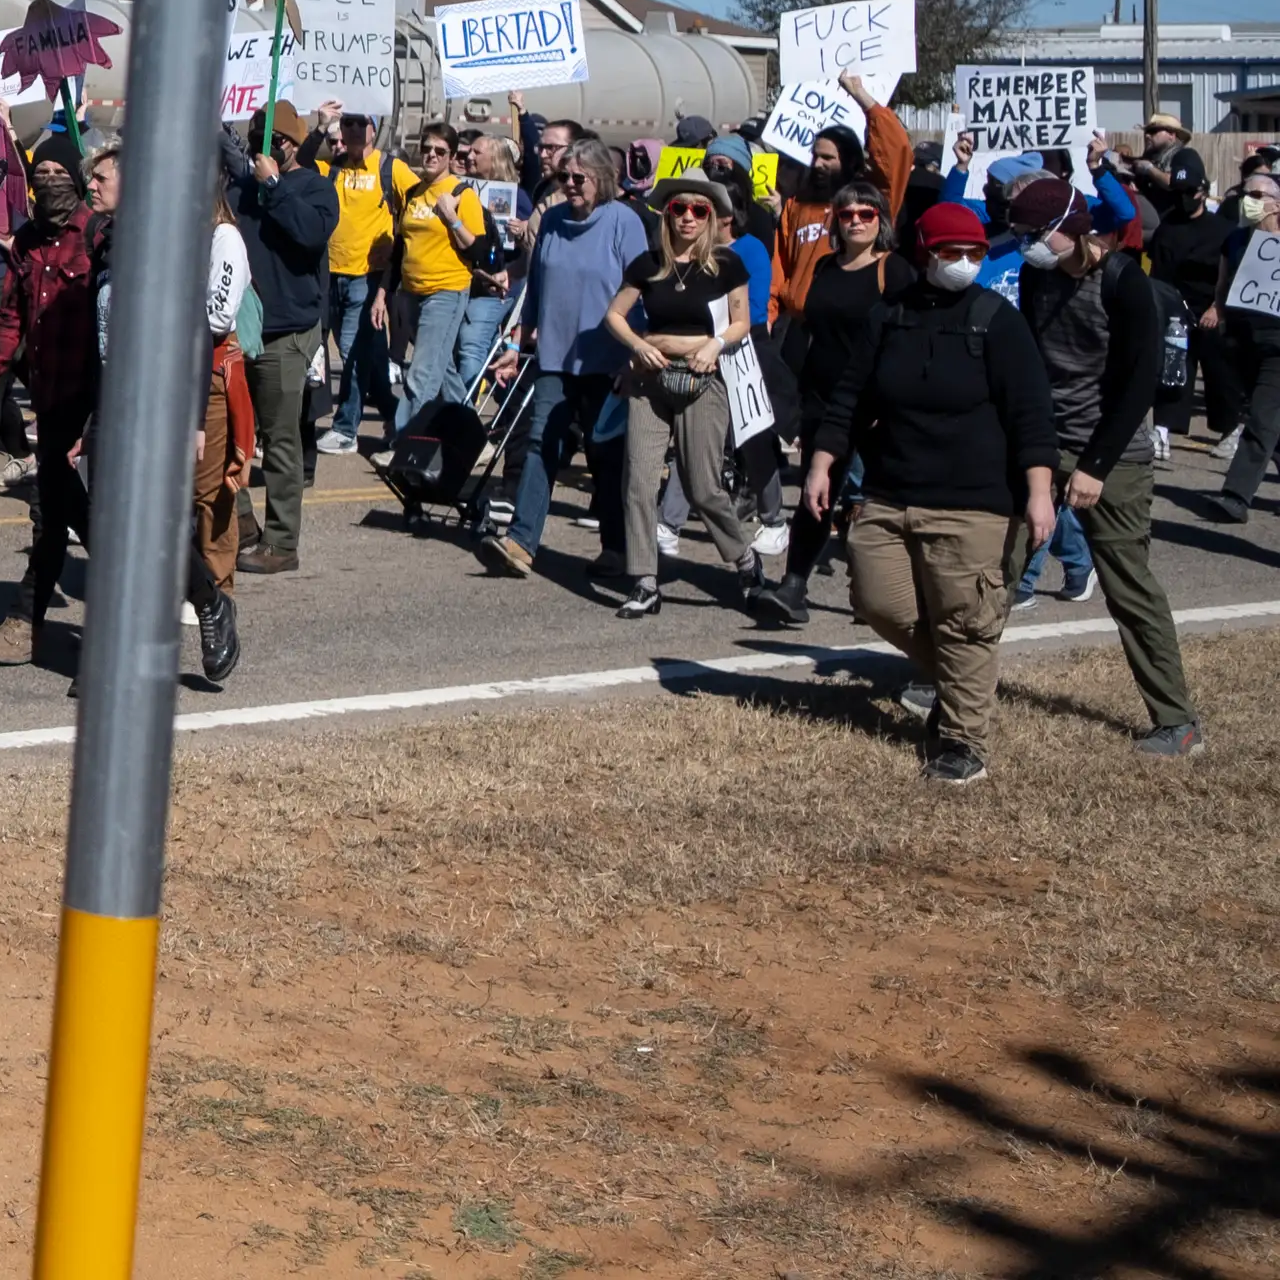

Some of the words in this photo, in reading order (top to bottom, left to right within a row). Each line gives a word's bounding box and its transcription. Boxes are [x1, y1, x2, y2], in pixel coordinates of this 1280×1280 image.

[14, 23, 89, 56] FAMILIA
[441, 1, 577, 59] LIBERTAD!
[794, 4, 892, 46] FUCK
[228, 39, 258, 61] WE
[302, 30, 392, 55] TRUMP'S
[821, 35, 884, 72] ICE
[296, 62, 391, 87] GESTAPO
[968, 69, 1087, 99] REMEMBER
[790, 83, 850, 125] LOVE
[798, 109, 827, 129] and
[967, 124, 1072, 151] JUAREZ
